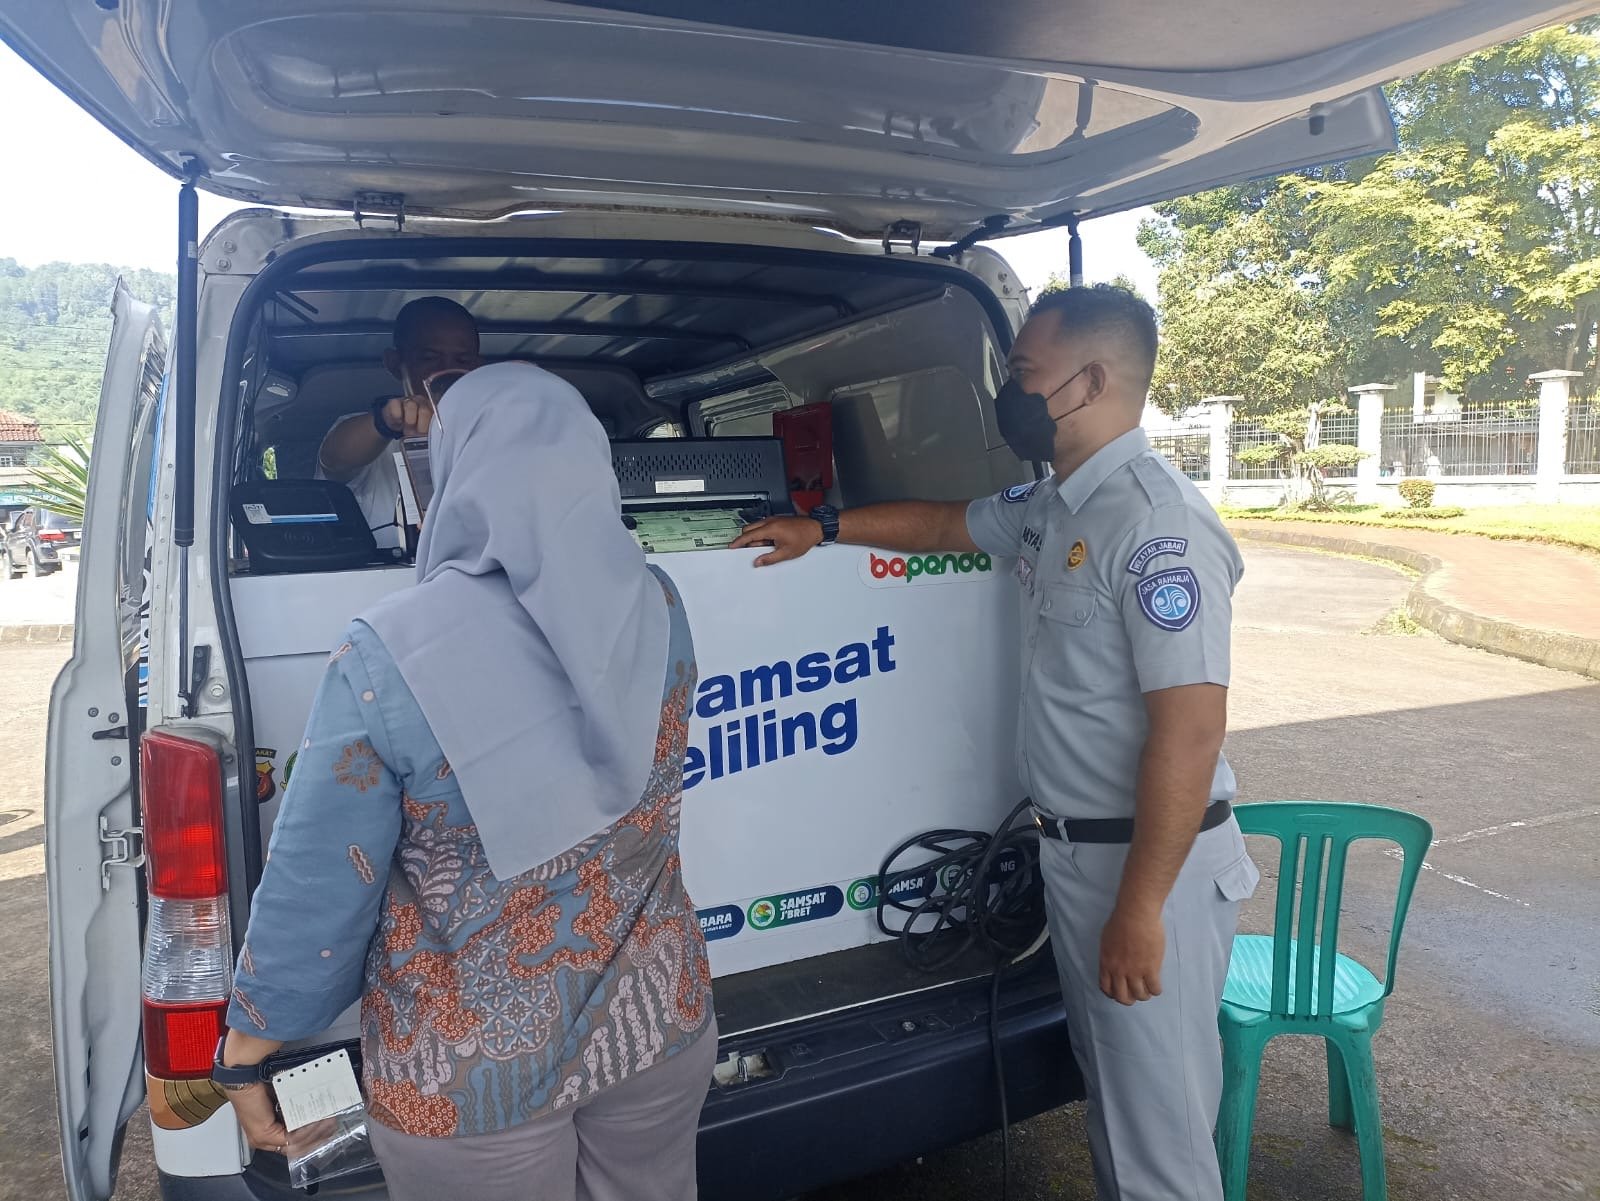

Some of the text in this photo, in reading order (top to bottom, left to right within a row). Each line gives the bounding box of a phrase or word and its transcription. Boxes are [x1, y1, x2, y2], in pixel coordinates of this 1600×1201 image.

[1158, 541, 1181, 551] JABAR
[870, 552, 992, 583] bapenda
[1141, 575, 1190, 595] JASA RAHARJA
[688, 625, 896, 718] amsat
[682, 698, 858, 791] eliling
[779, 891, 827, 911] SAMSAT
[698, 912, 733, 929] BARA
